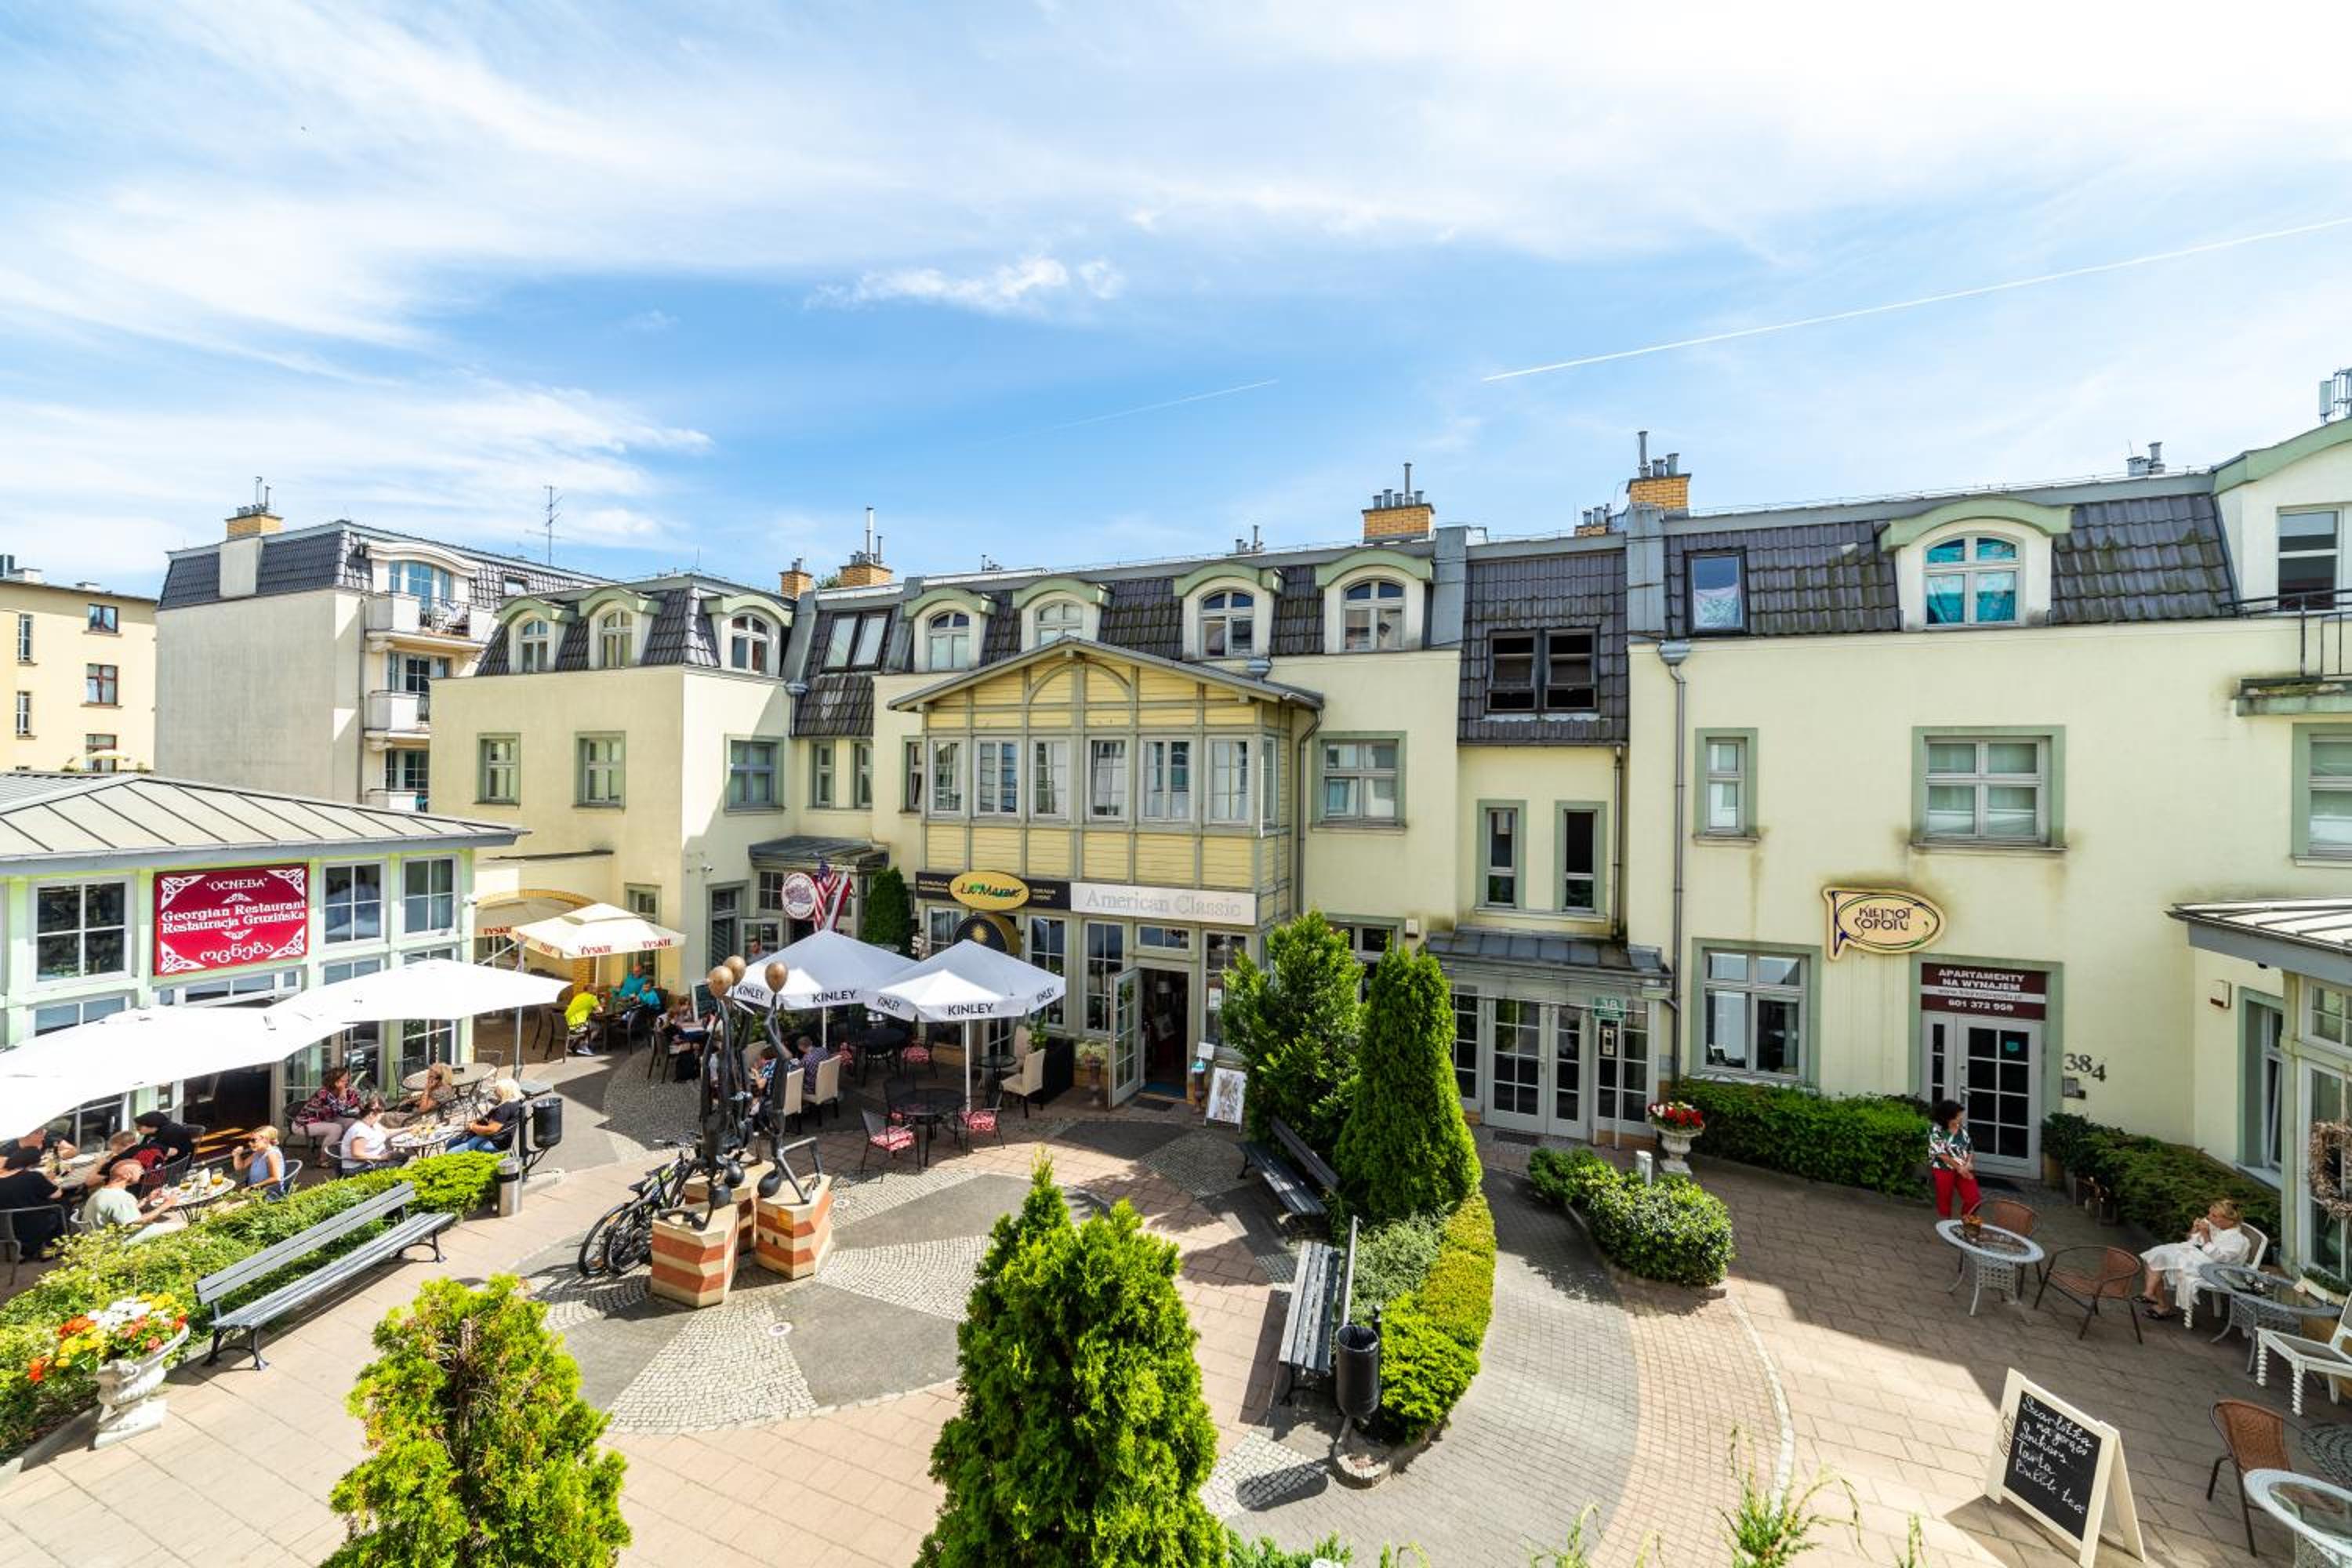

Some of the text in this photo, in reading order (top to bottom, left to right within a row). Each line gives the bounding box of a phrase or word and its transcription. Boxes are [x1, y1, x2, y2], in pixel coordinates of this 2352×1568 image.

[162, 899, 305, 922] Georgian Restaurant
[1086, 889, 1241, 916] American Classic
[162, 910, 305, 934] Restauracja Gruzińska
[1938, 968, 2025, 982] APARTAMENTY
[1942, 978, 2020, 992] NA WYNAJEM
[812, 989, 856, 1004] KINLEY
[948, 1003, 993, 1016] KINLEY
[2016, 1436, 2056, 1475] Tarta
[2061, 1488, 2086, 1515] tea
